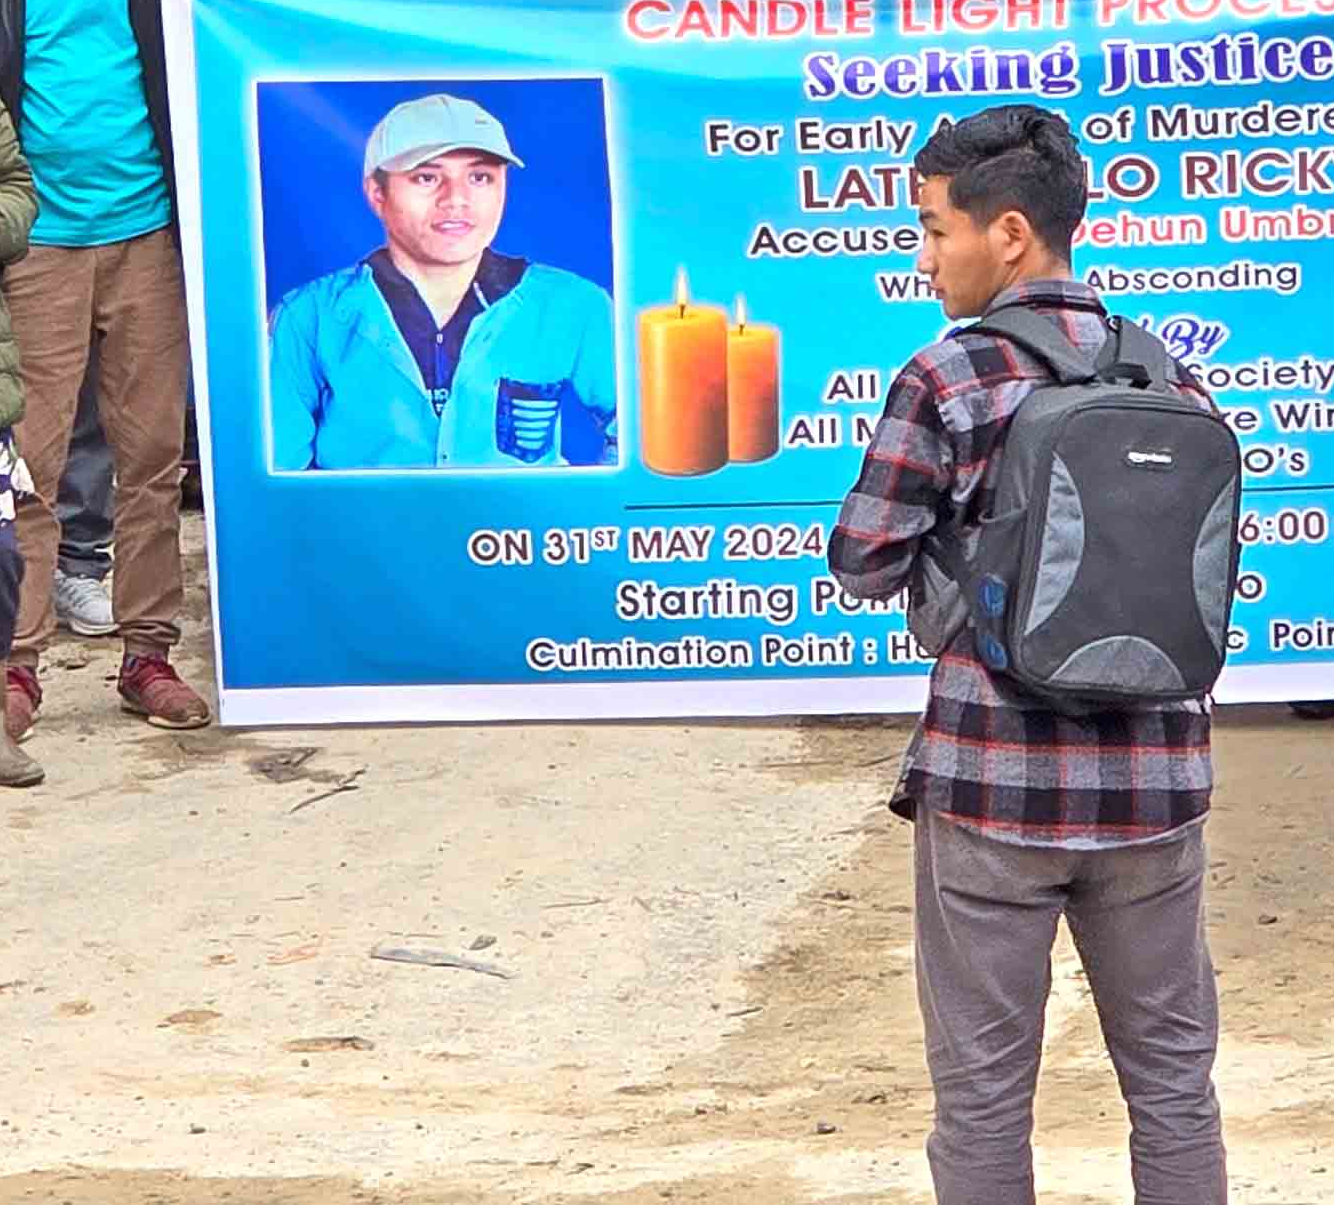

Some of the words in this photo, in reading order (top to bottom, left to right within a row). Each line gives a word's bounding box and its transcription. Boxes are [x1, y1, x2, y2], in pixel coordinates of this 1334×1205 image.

[806, 45, 1076, 98] Seeking
[1106, 36, 1334, 92] Justice
[708, 123, 780, 153] For
[800, 119, 912, 154] Early
[1086, 109, 1131, 140] of
[751, 225, 919, 256] Accuse
[1087, 263, 1297, 292] Absconding
[1165, 319, 1225, 356] By
[828, 374, 876, 400] All
[788, 417, 837, 444] All
[471, 534, 529, 561] ON
[547, 531, 618, 561] 31ST
[632, 530, 711, 559] MAY
[727, 528, 823, 556] 2024
[1239, 512, 1326, 541] 6:00
[619, 583, 795, 620] Starting
[528, 637, 749, 667] Culmination
[763, 636, 851, 665] Point
